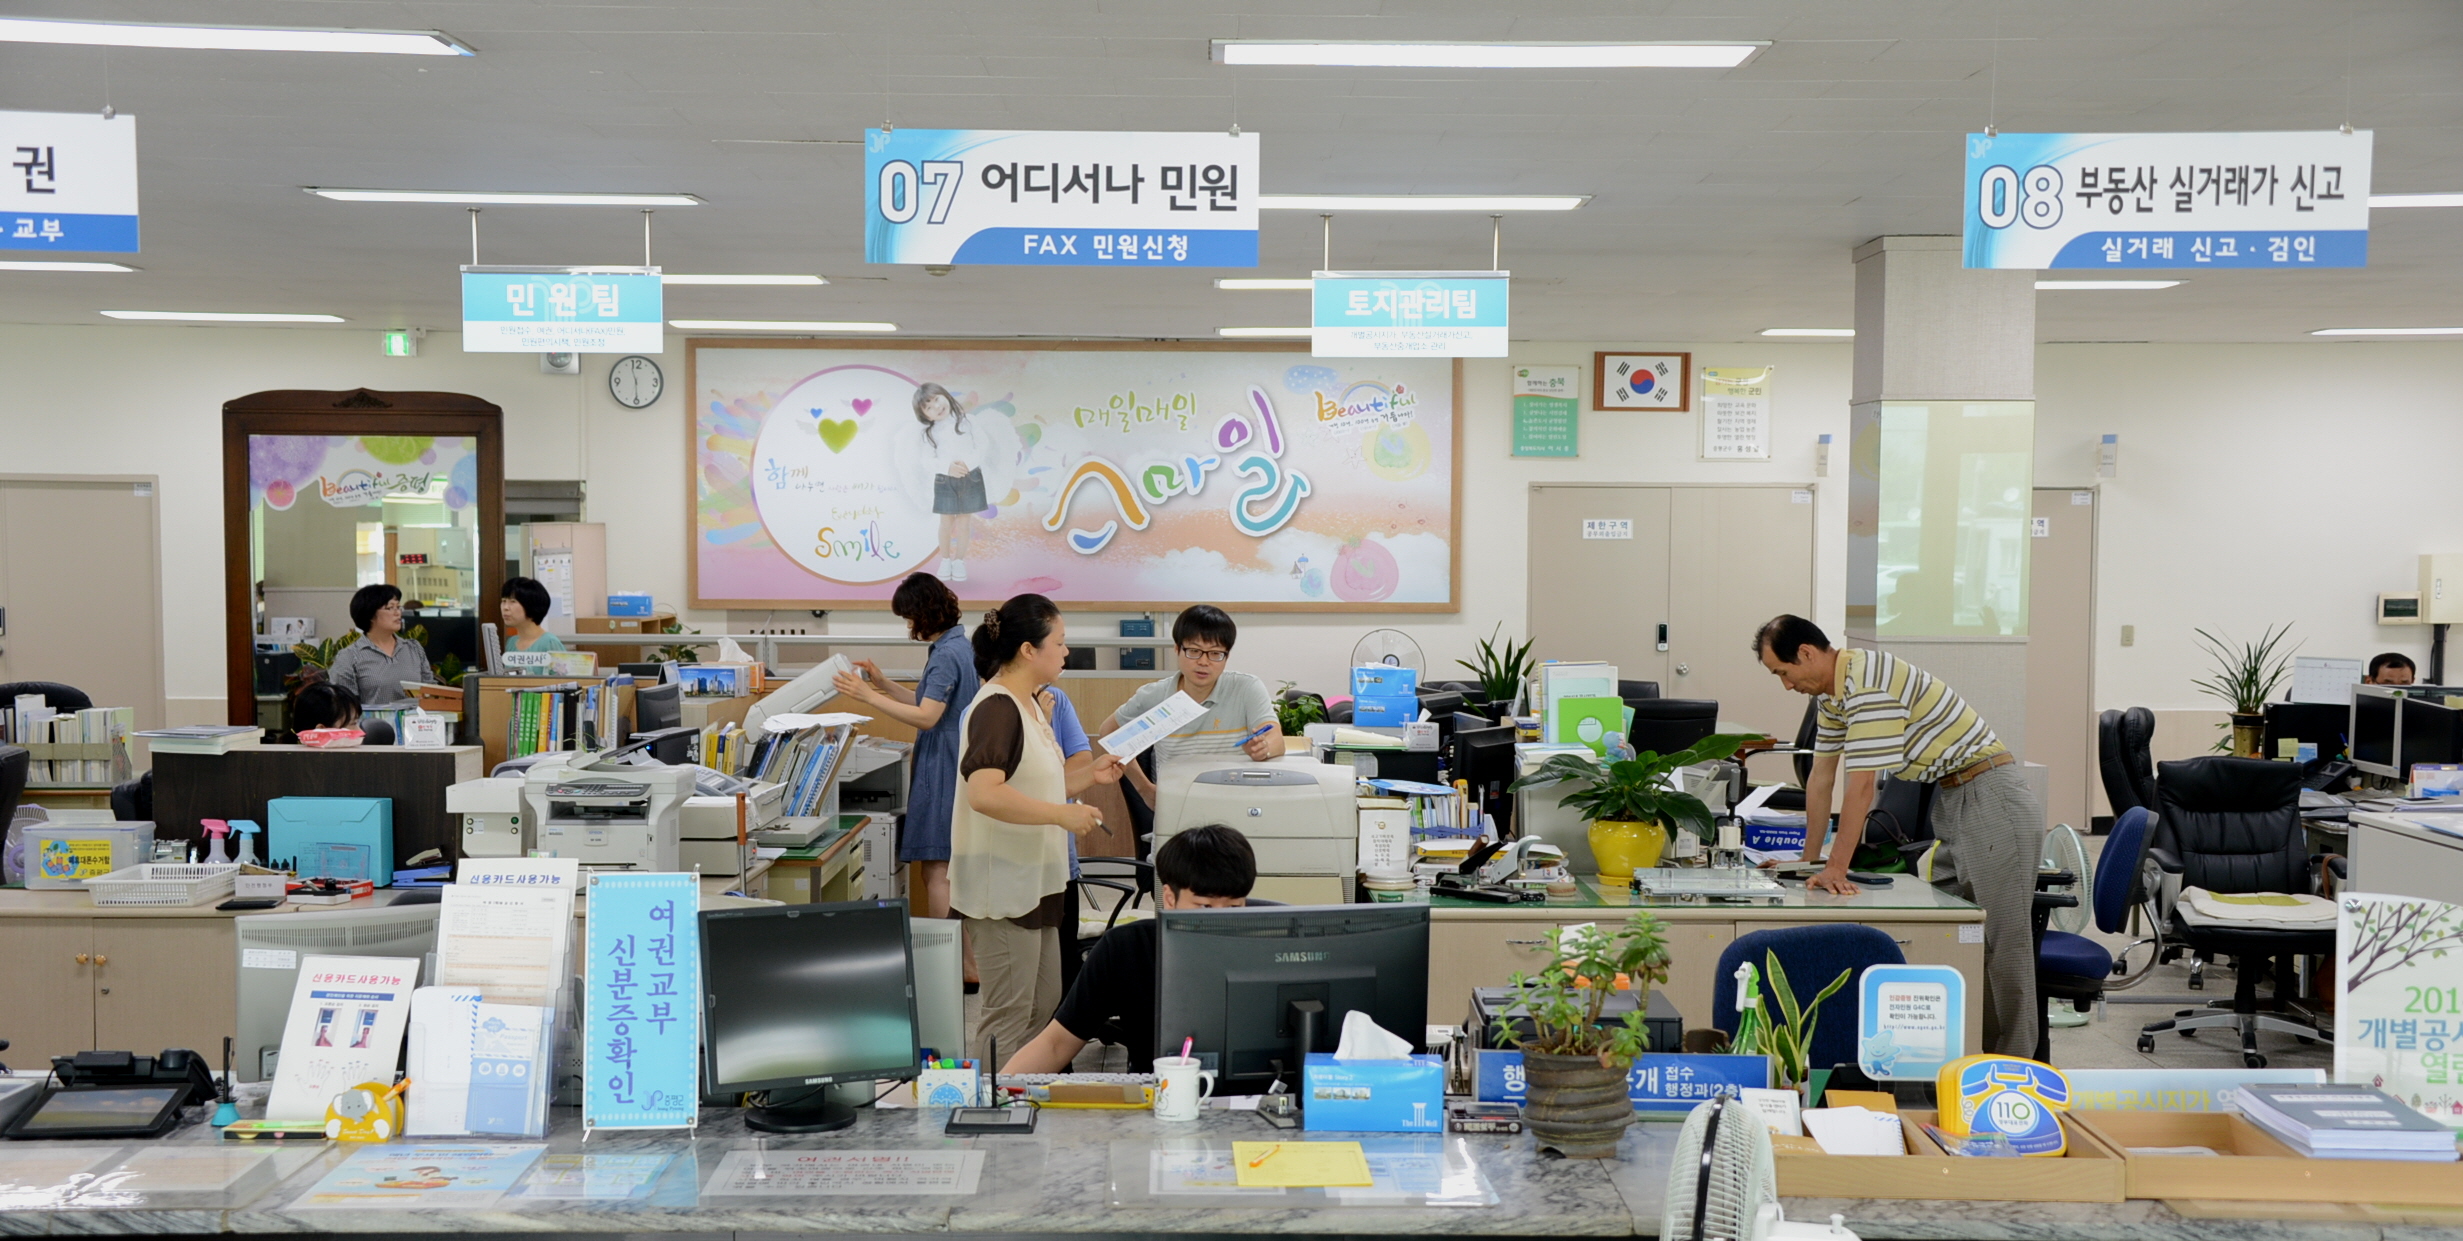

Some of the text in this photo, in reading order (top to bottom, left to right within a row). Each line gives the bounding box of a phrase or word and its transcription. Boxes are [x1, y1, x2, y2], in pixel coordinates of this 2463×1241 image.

[12, 146, 56, 194] 권
[878, 159, 963, 225] 07
[981, 162, 1238, 212] 어디서나 민원
[1977, 164, 2064, 230] 08
[2075, 164, 2345, 215] 부동산 실거래가 신고
[12, 218, 65, 242] 교부
[1023, 234, 1189, 261] FAX 민원신청
[2101, 236, 2317, 262] 실거래 신고 검인
[1344, 289, 1477, 319] 토지관리팀
[1430, 341, 1446, 351] 관리
[630, 359, 642, 370] 12
[614, 376, 659, 387] 9 3
[1549, 377, 1565, 388] 충북
[1748, 387, 1762, 396] 군민
[1073, 390, 1197, 433] 매일매일
[1314, 390, 1416, 422] Beautiful
[764, 458, 808, 490] 함께
[1045, 388, 1309, 550] 스마일
[320, 475, 389, 497] Beautiful
[795, 481, 825, 493] 나누면
[815, 520, 900, 561] Smile
[506, 654, 544, 665] 여권심사
[1752, 835, 1806, 847] Double A
[469, 874, 561, 885] 신용카드사용가능
[645, 899, 678, 1036] 여권교부
[1274, 951, 1331, 963] SAMSUNG
[312, 973, 402, 986] 신용카드사용가능
[1889, 1003, 1912, 1011] 전자민원
[2404, 985, 2463, 1014] 201
[605, 934, 639, 1104] 신분증확인
[804, 1075, 833, 1085] SAMSUNG
[1664, 1066, 1695, 1082] 접수
[1996, 1102, 2031, 1120] 110
[2071, 1089, 2212, 1112] 개별공시지가
[1402, 1119, 1414, 1127] The
